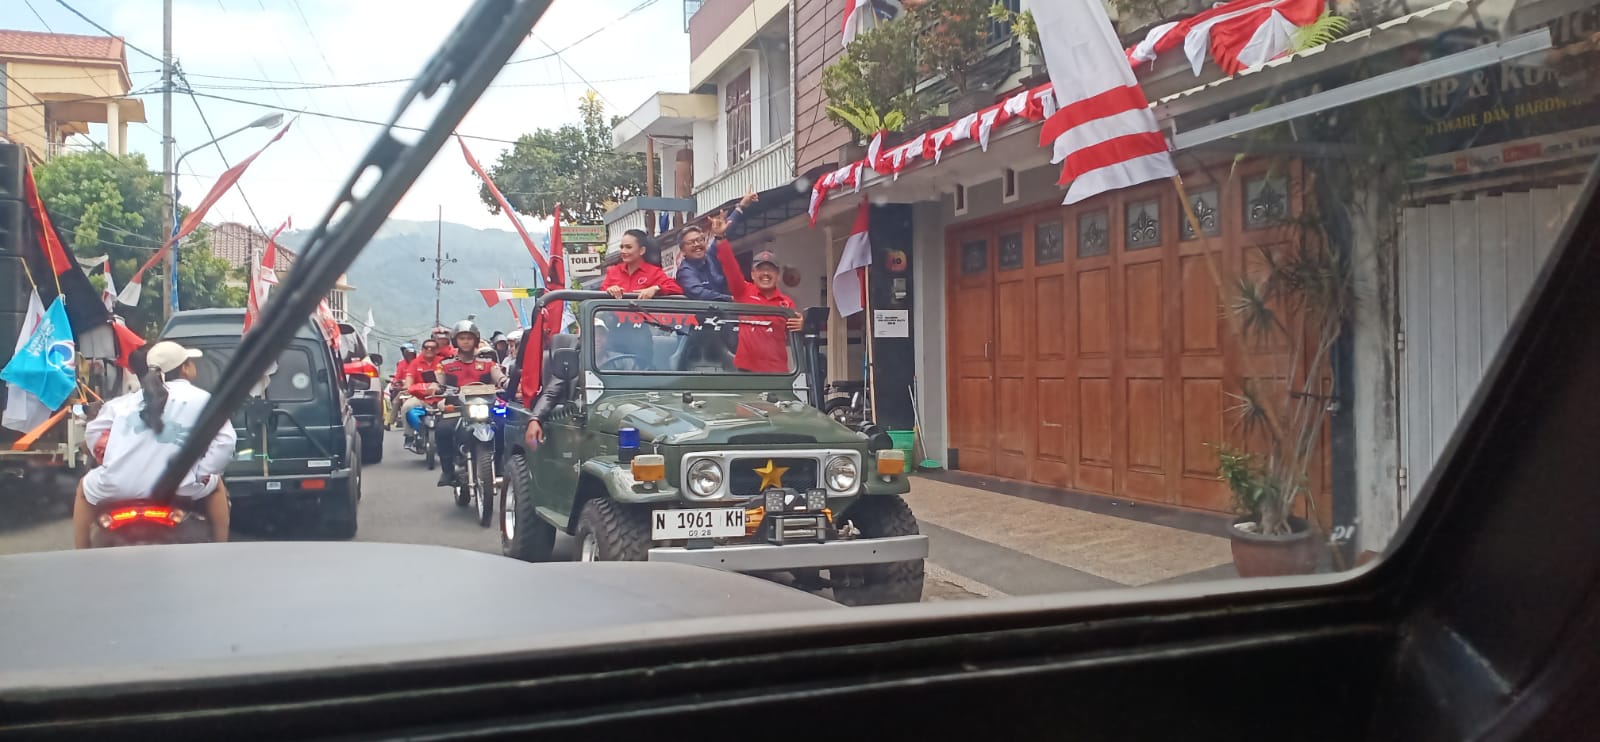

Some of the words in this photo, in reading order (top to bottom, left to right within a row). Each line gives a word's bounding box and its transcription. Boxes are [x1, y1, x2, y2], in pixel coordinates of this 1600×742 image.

[571, 256, 598, 265] TOILET
[616, 321, 773, 332] INONESIA
[656, 513, 666, 530] N
[677, 511, 713, 529] 1961
[725, 510, 744, 527] KH
